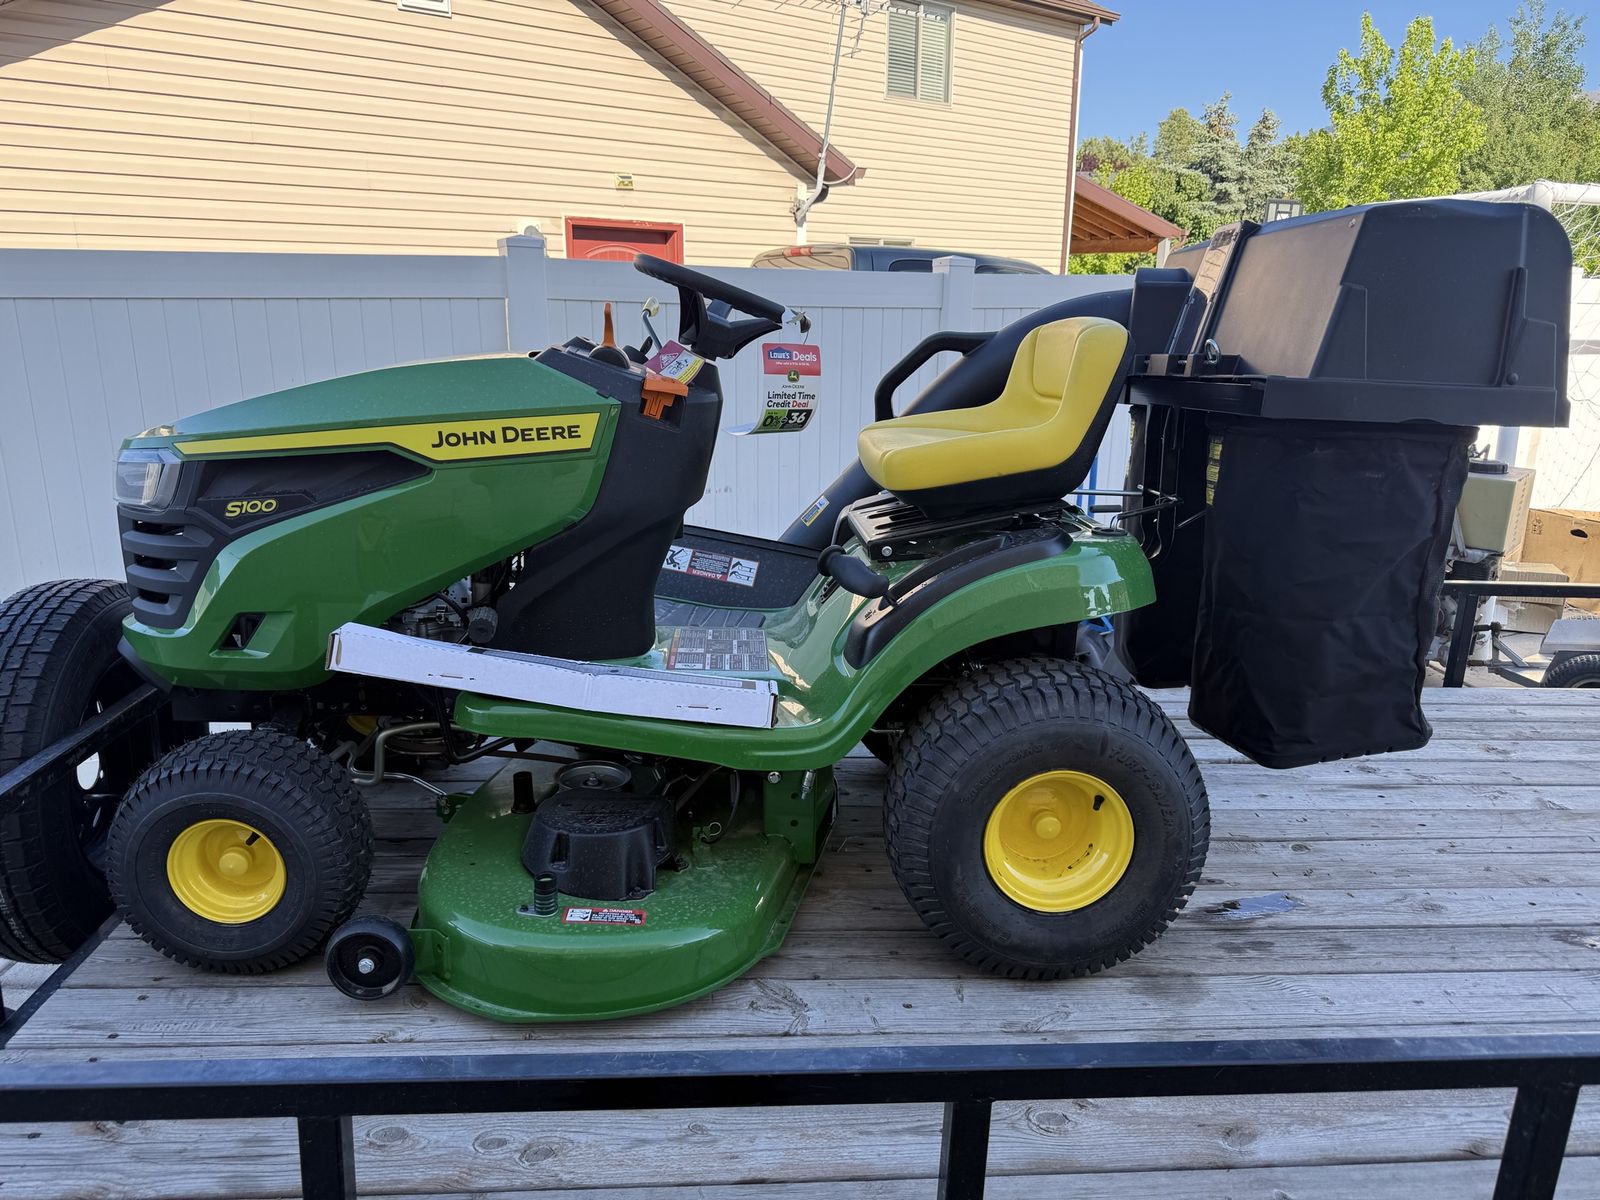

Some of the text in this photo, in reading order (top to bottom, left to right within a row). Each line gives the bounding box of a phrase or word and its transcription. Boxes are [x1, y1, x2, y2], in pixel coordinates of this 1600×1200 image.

[792, 351, 817, 362] Deals
[767, 391, 816, 400] Limited Time
[767, 400, 810, 408] Credit Deal
[788, 412, 807, 424] 36
[431, 424, 581, 449] JOHN DEERE
[225, 499, 277, 517] S100
